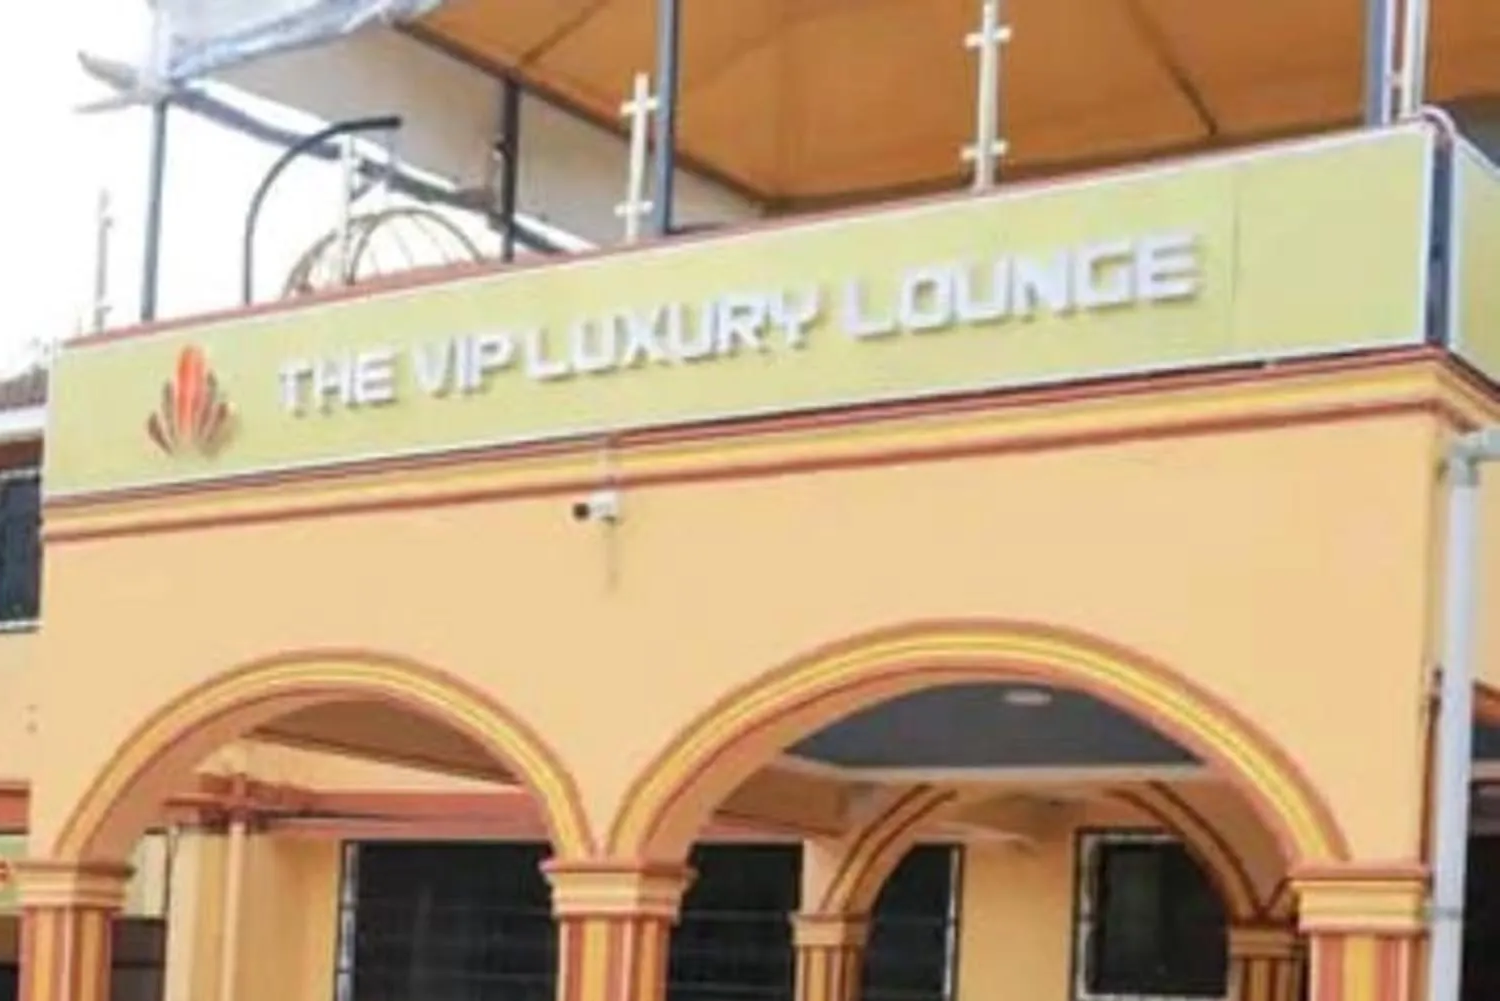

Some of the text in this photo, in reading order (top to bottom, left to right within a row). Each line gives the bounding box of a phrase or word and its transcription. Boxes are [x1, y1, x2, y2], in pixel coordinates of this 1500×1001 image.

[279, 232, 1198, 413] THE VIP LUXURY LOUNGE
